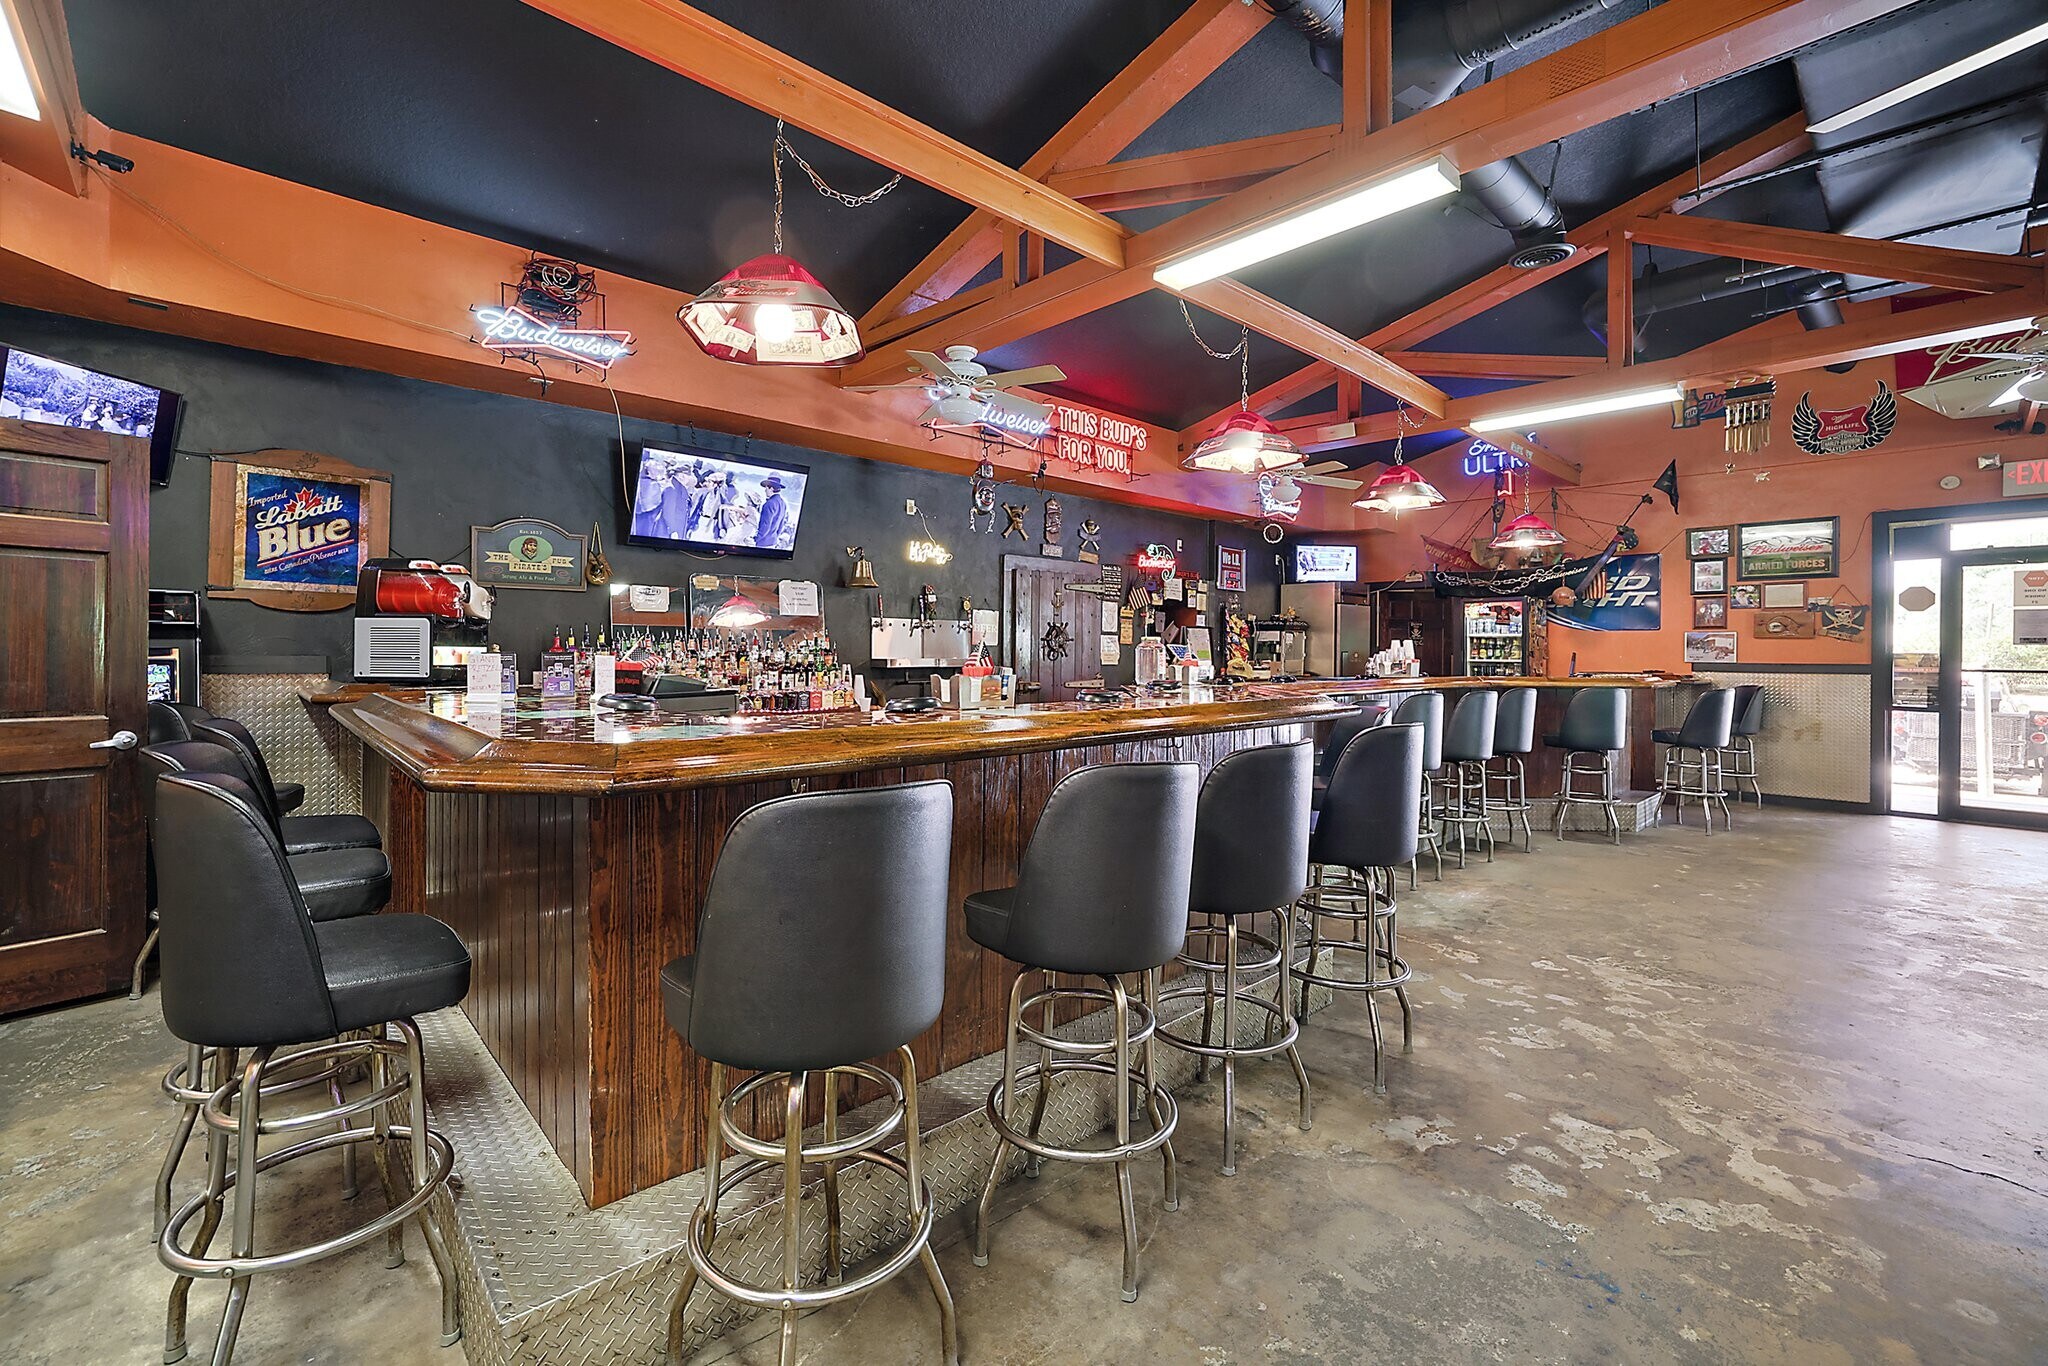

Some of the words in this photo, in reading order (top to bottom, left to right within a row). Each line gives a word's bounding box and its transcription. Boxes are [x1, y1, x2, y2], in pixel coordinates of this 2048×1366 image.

[476, 309, 629, 358] Budweiser
[1057, 406, 1098, 438] THIS
[1101, 416, 1147, 451] BUD'S
[1057, 434, 1092, 465] FOR
[1094, 446, 1131, 474] YOU.
[248, 489, 288, 508] Imported
[255, 495, 343, 529] Labatt
[257, 518, 352, 561] Blue
[1749, 543, 1824, 556] Budweiser
[513, 562, 548, 571] PIRATE'S
[1138, 554, 1176, 569] Budweiser
[1749, 561, 1784, 571] ARMED
[1786, 559, 1826, 569] FORCES
